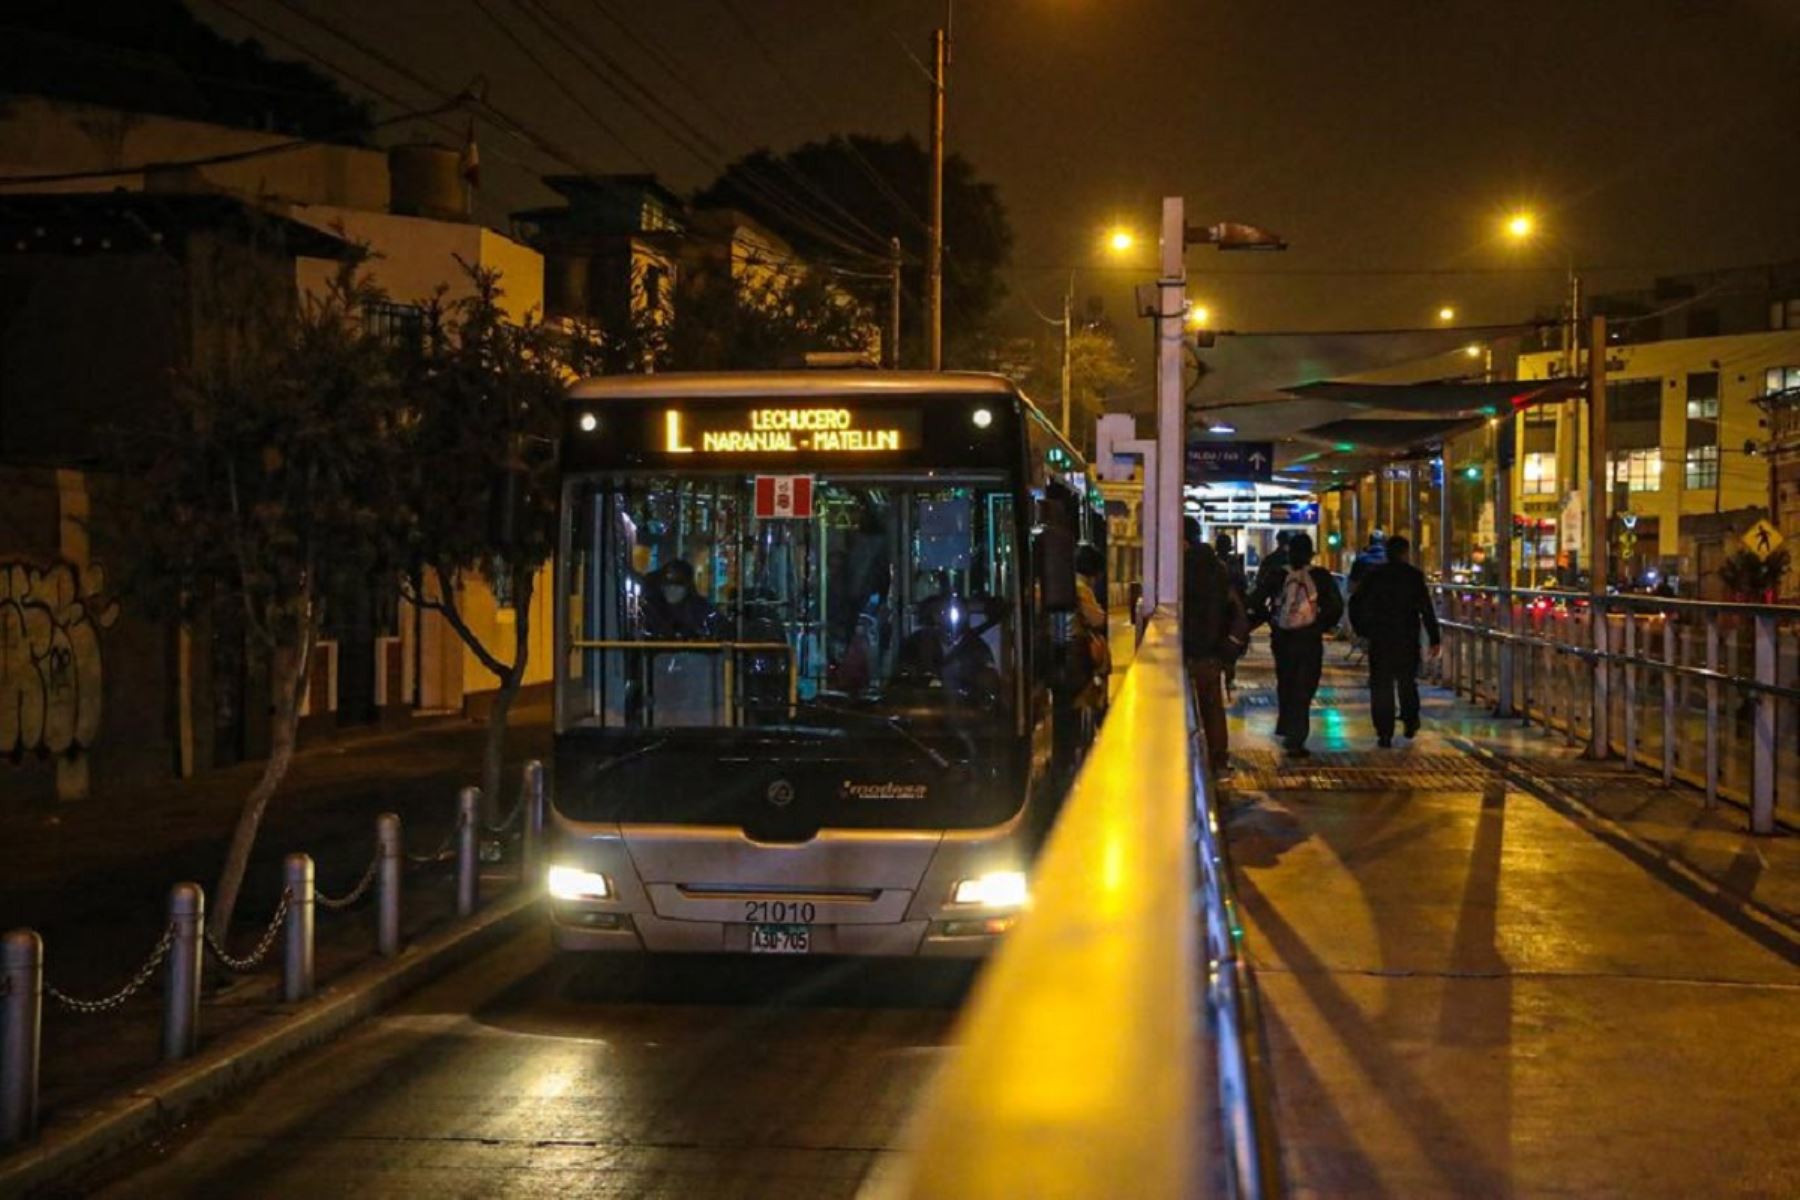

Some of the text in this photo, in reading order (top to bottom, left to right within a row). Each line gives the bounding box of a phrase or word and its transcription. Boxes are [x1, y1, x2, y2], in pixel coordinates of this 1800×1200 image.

[752, 408, 850, 430] LECHUCERO
[666, 410, 693, 453] L
[703, 431, 797, 451] NARANJAL
[814, 430, 899, 451] MATELLINI
[746, 901, 816, 923] 21010
